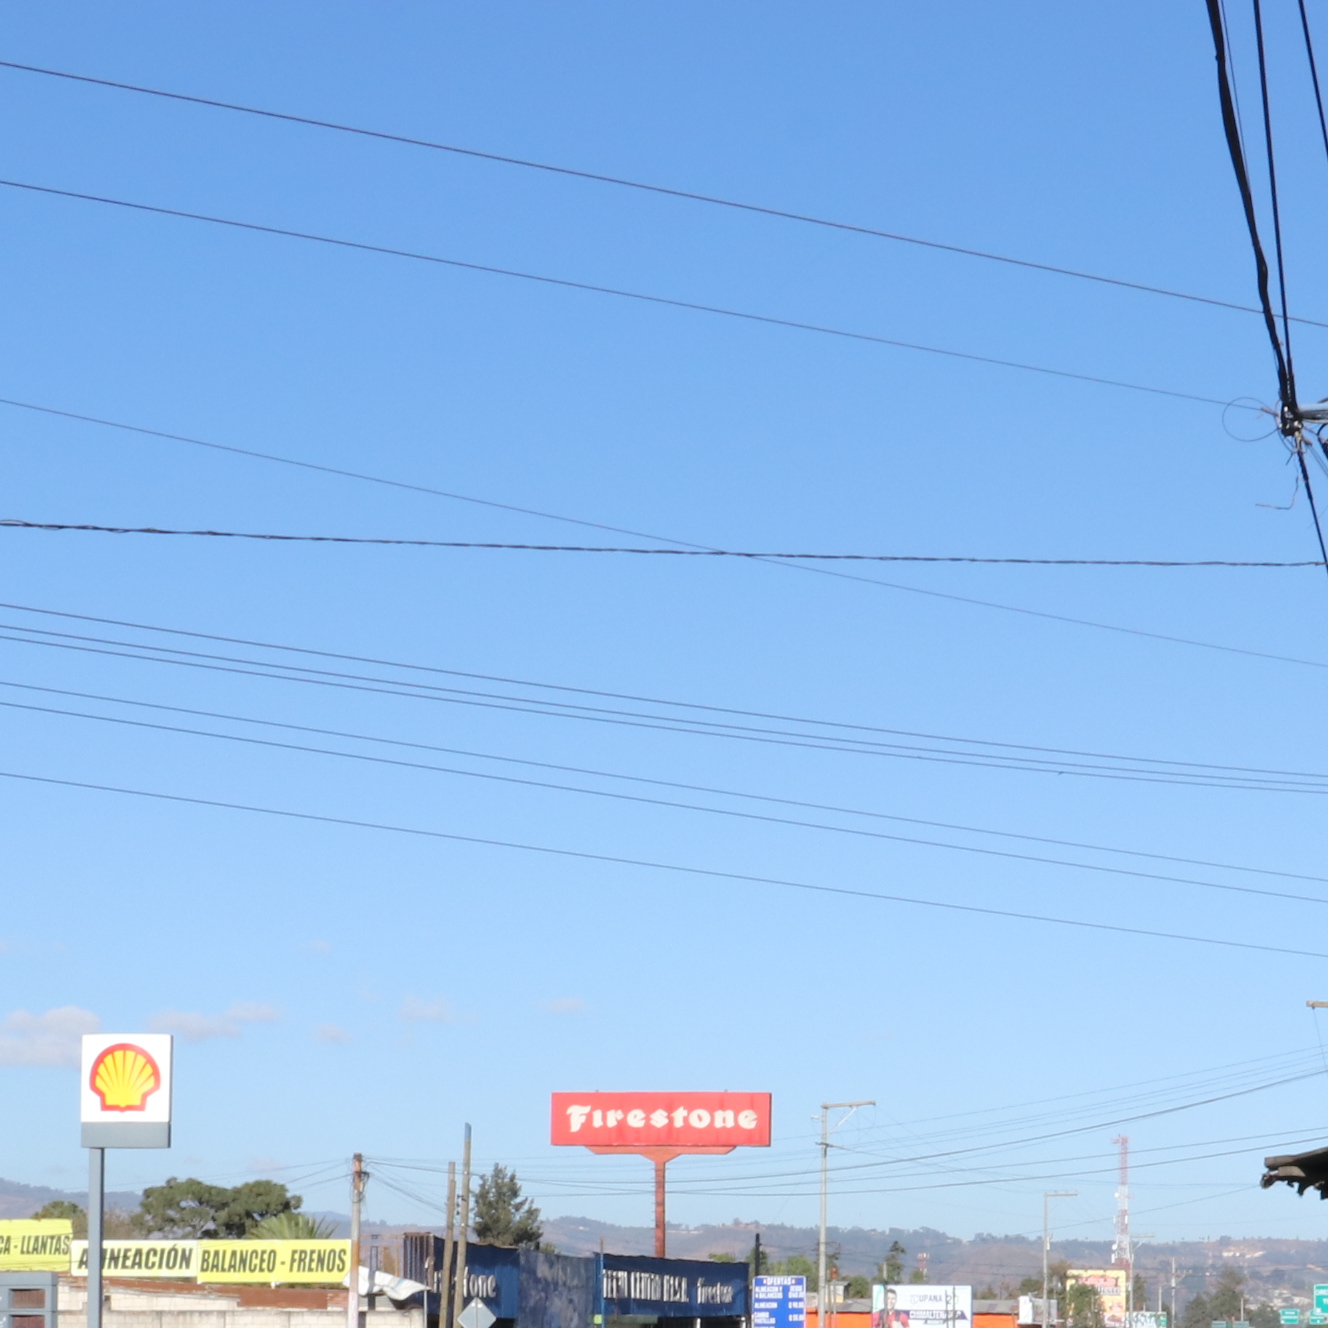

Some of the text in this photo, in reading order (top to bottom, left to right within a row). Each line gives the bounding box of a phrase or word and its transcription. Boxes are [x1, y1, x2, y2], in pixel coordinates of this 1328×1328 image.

[566, 1105, 758, 1132] Firestone
[20, 1235, 71, 1255] LLANTAS
[200, 1250, 277, 1273] BALANCEO
[289, 1249, 347, 1272] FRENOS
